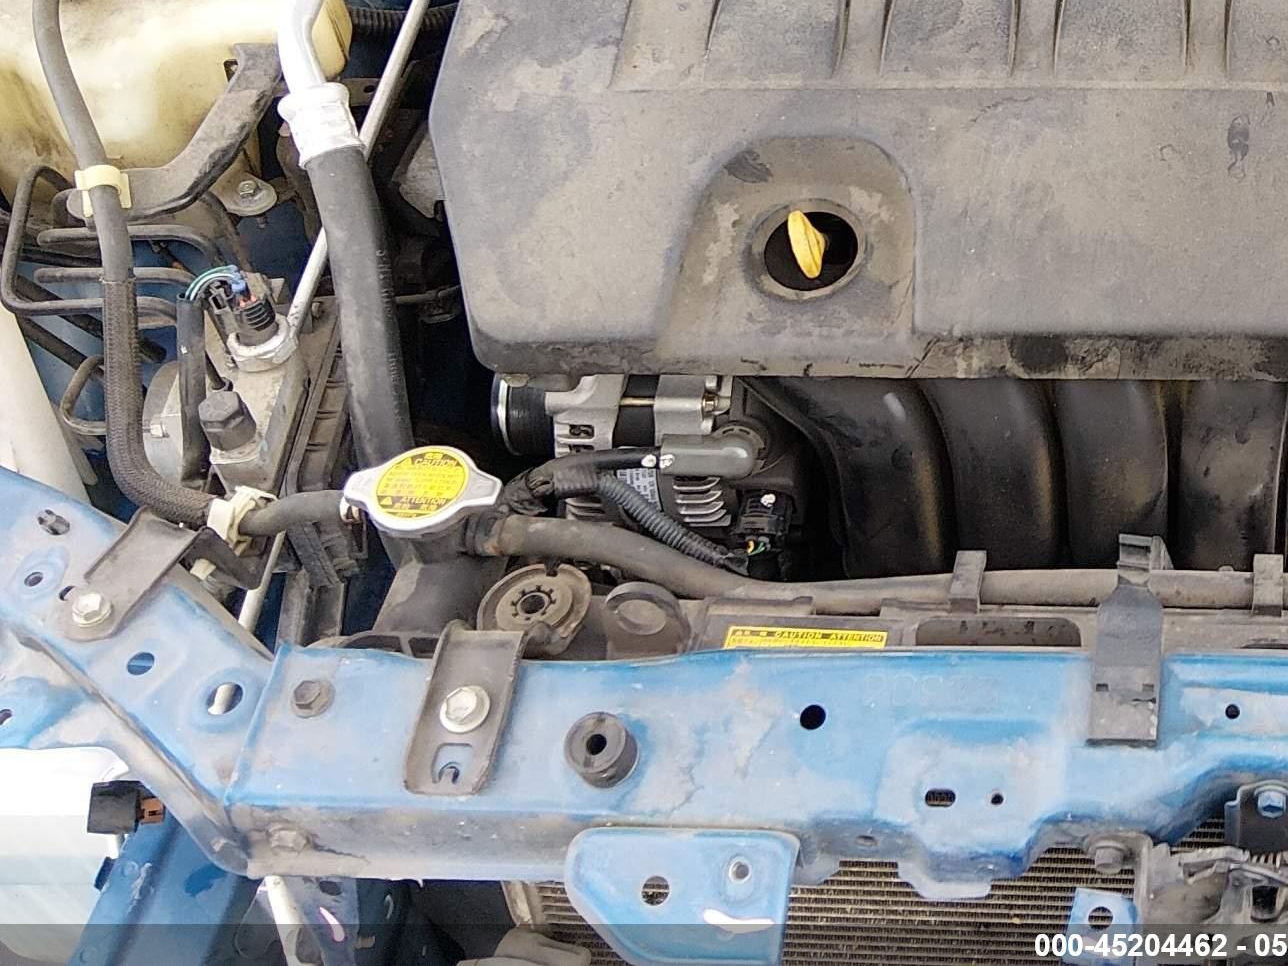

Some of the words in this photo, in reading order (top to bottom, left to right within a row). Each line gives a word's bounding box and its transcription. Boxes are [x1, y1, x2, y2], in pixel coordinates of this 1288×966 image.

[414, 458, 457, 467] CAUTION
[400, 496, 447, 505] ATTENTION
[774, 631, 822, 639] CAUTION
[830, 633, 882, 641] ATTENTION
